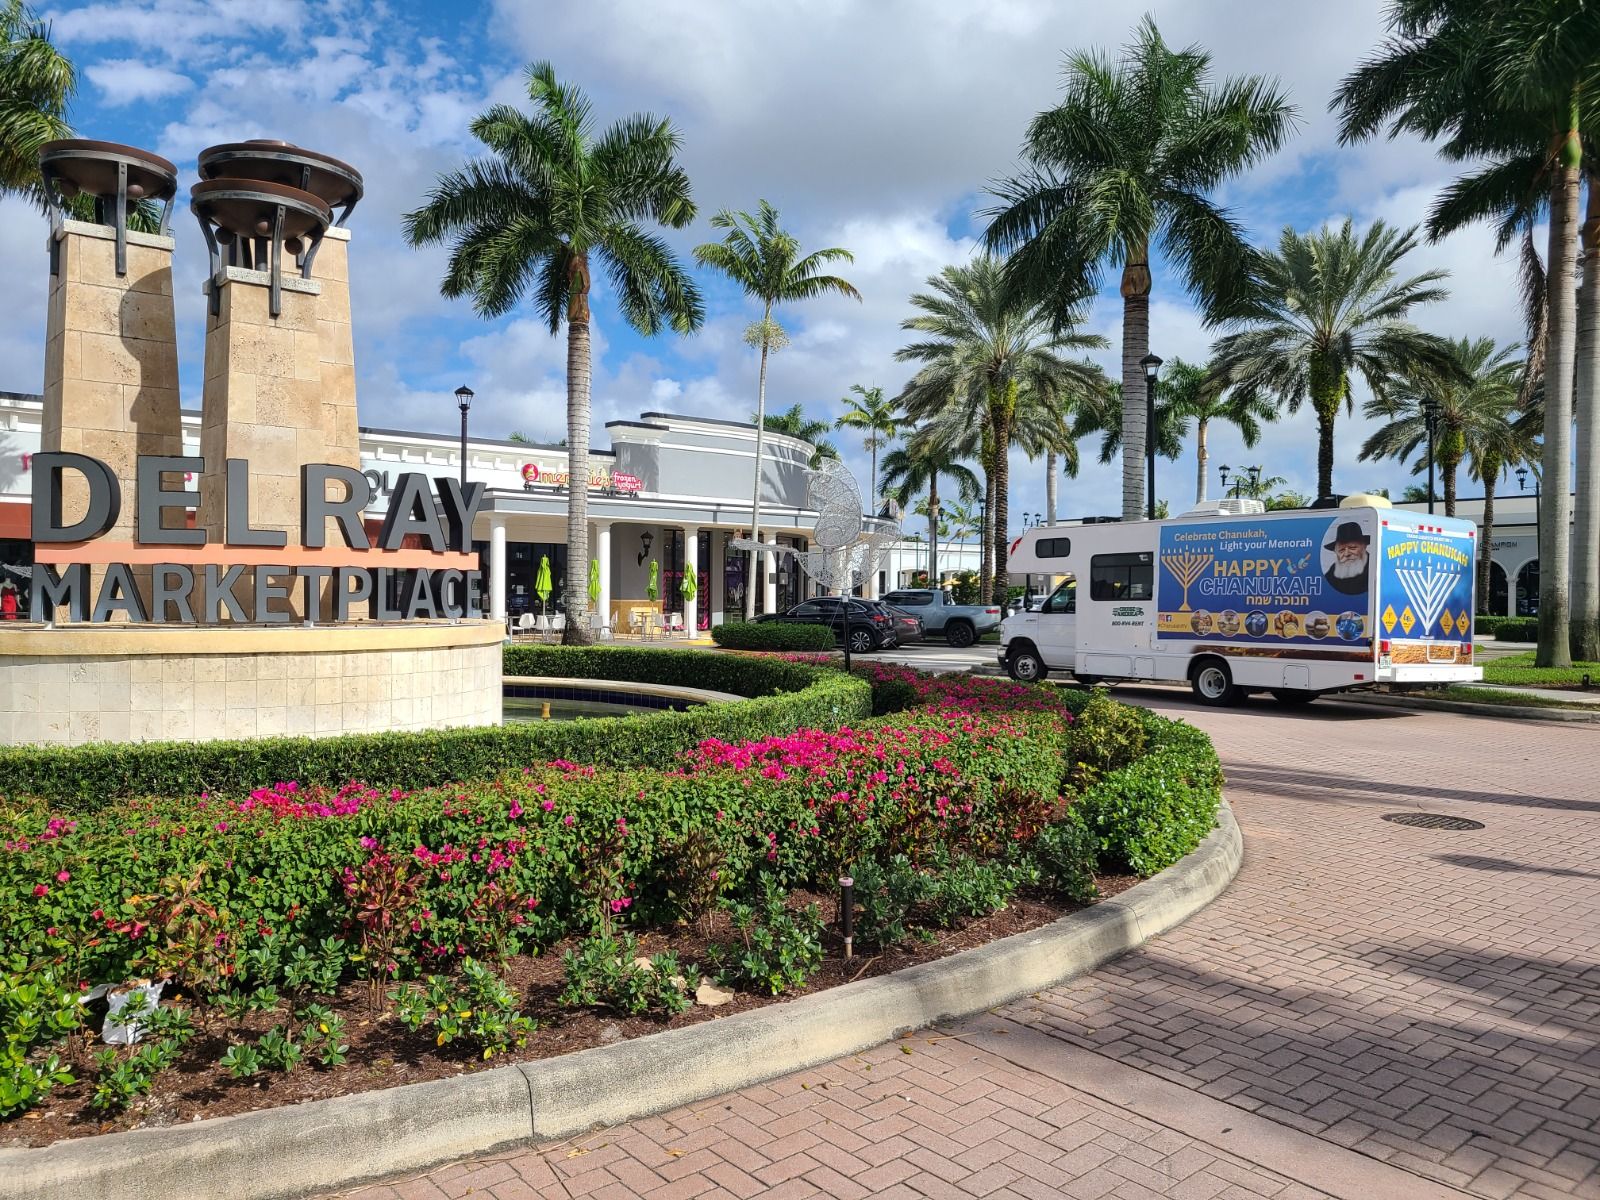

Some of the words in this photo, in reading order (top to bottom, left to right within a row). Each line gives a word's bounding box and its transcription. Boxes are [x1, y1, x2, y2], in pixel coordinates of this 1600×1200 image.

[614, 472, 637, 482] frozen
[617, 480, 642, 490] yogurt
[31, 451, 487, 553] DELRAY
[1174, 532, 1217, 542] Celebrate
[1218, 529, 1268, 540] Chanukah,
[1219, 541, 1243, 552] Light
[1244, 542, 1267, 552] your
[1268, 538, 1313, 549] Menorah
[1387, 541, 1419, 560] HAPPY
[1420, 541, 1469, 567] CHANUKAH
[1213, 559, 1283, 577] HAPPY
[30, 562, 483, 624] MARKETPLACE
[1199, 576, 1322, 596] CHANUKAH
[1246, 595, 1272, 606] שמח
[1274, 595, 1310, 606] חנוכה
